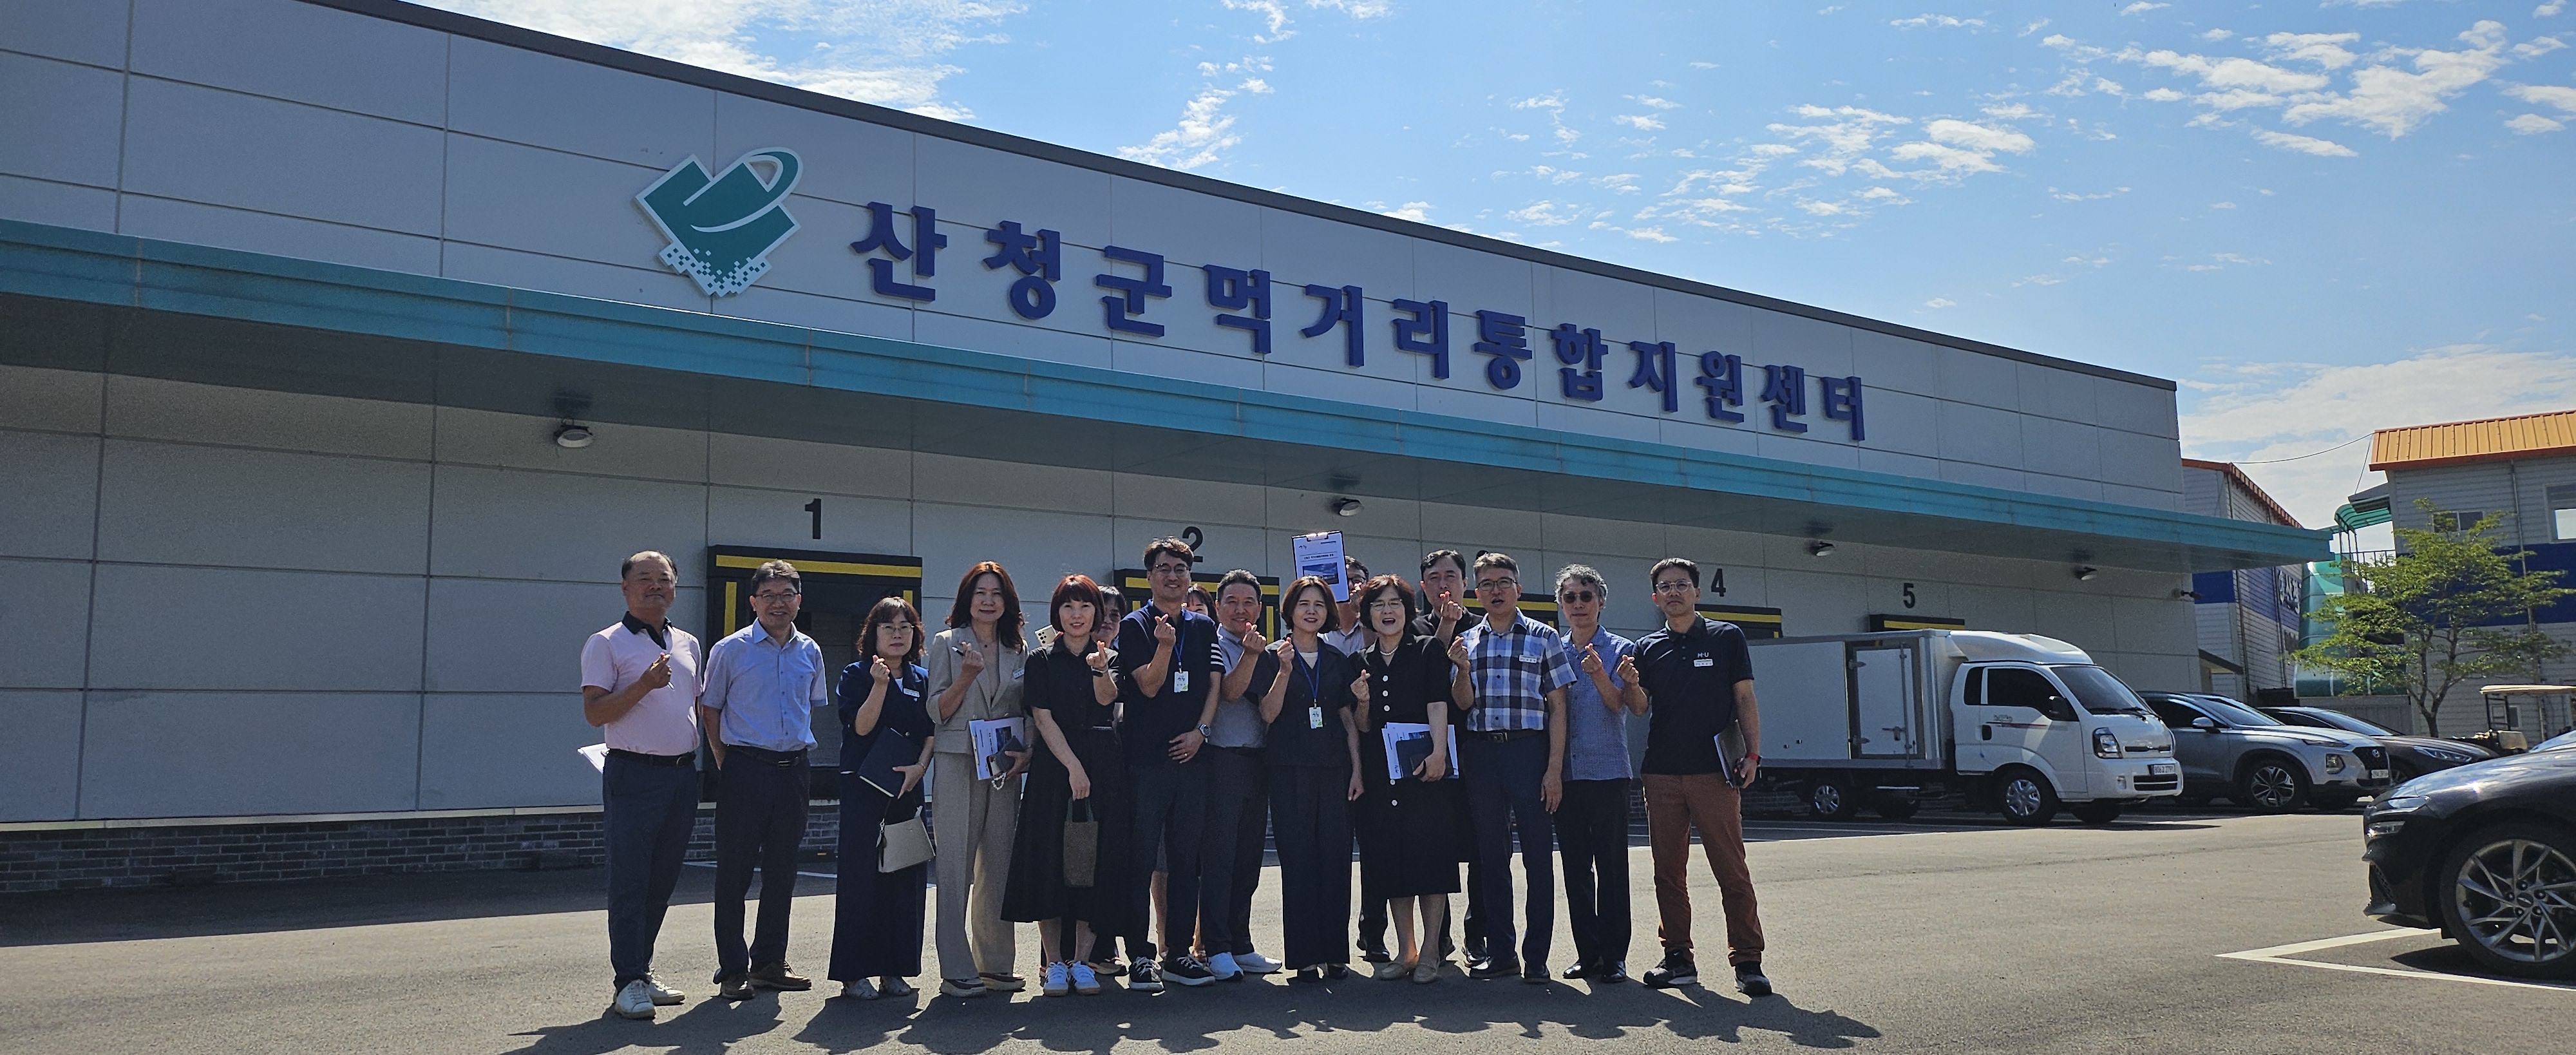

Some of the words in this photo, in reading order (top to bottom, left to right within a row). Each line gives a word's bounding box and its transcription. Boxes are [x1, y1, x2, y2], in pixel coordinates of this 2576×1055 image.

[850, 202, 1866, 442] 산청군먹거리통합지원센터
[805, 499, 821, 539] 1
[1182, 526, 1203, 562] 2
[1710, 569, 1727, 598] 4
[1903, 582, 1916, 609] 5
